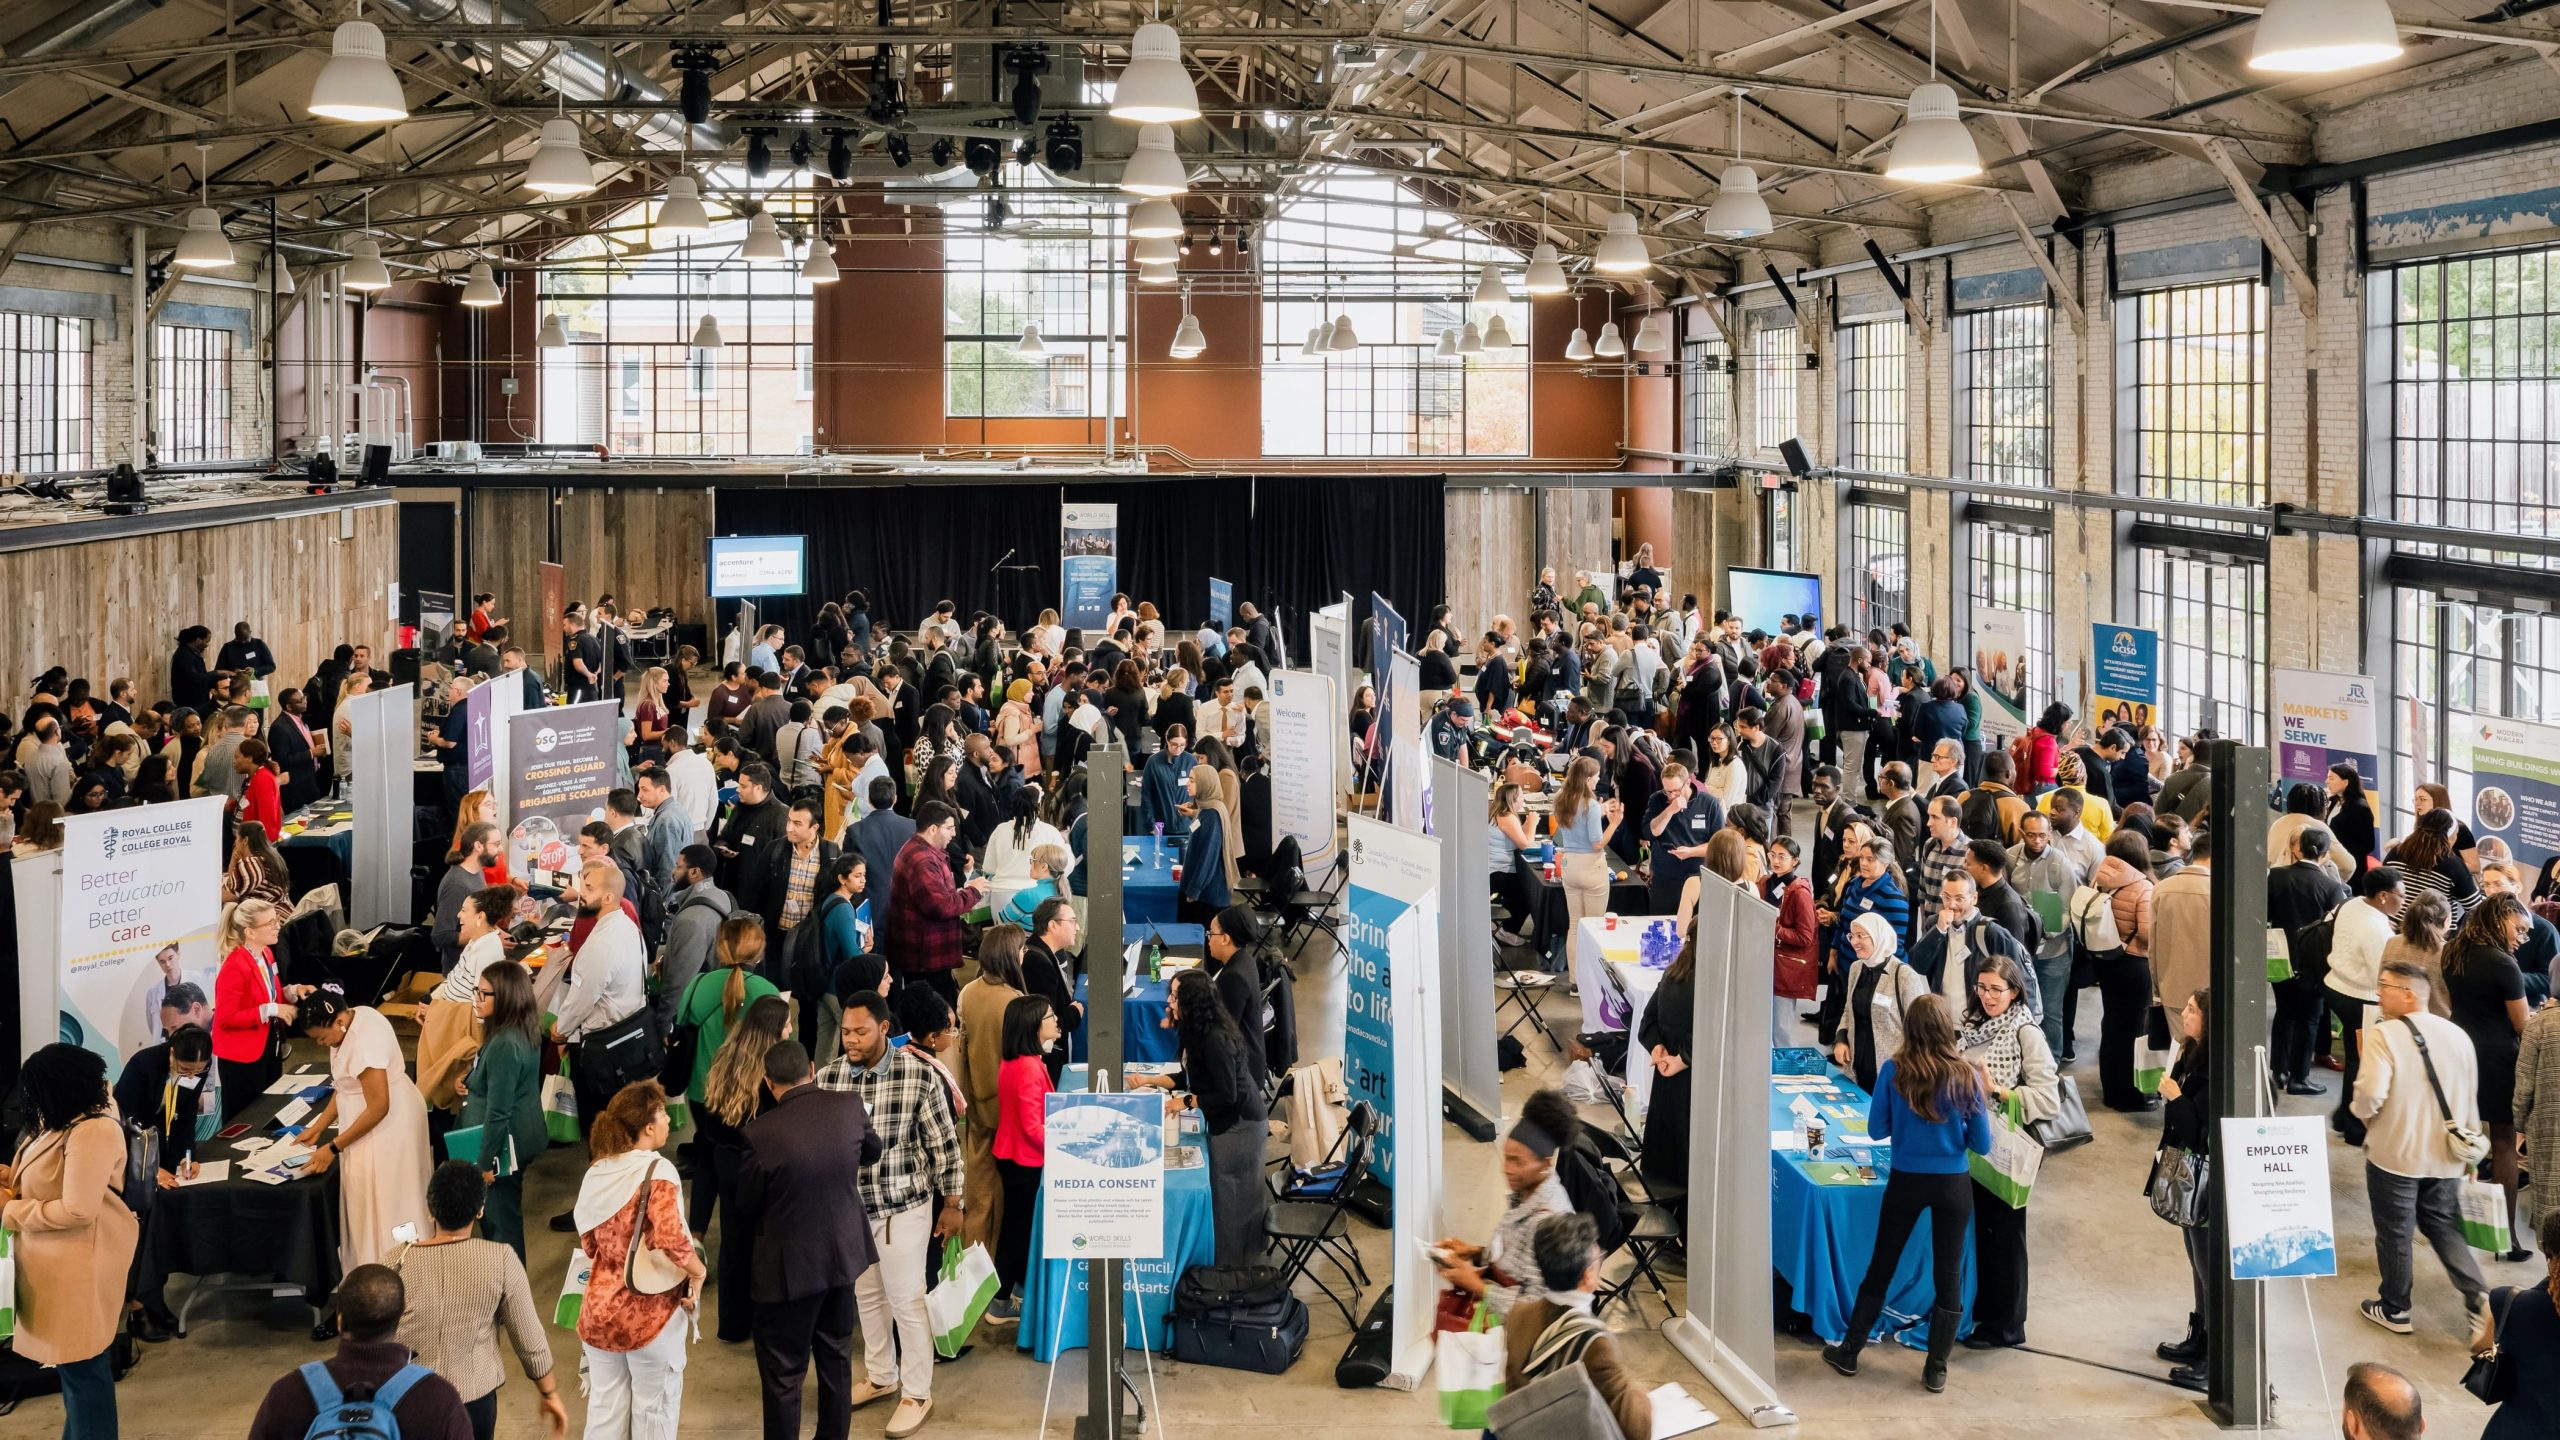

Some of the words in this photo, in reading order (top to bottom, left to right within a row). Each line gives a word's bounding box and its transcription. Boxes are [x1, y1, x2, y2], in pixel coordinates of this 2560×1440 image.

[718, 559, 754, 567] accenture
[2112, 645, 2137, 655] OCISO
[1275, 708, 1306, 719] Welcome
[2283, 703, 2348, 721] MARKETS
[2283, 716, 2304, 729] WE
[2285, 730, 2327, 745] SERVE
[2496, 729, 2524, 738] MODERN
[2496, 735, 2524, 744] NIAGARA
[525, 766, 571, 780] CROSSING
[574, 761, 606, 773] GUARD
[2475, 753, 2505, 766] MAKING
[2507, 760, 2549, 774] BUILDINGS
[519, 794, 567, 809] BRIGADIER
[569, 786, 611, 800] SCOLAIRE
[2521, 795, 2535, 803] WHO
[2544, 800, 2557, 808] ARE
[122, 828, 151, 838] ROYAL
[152, 821, 192, 834] COLLEGE
[163, 835, 192, 846] ROYAL
[540, 848, 564, 866] STOP
[81, 869, 138, 891] Better
[98, 880, 185, 907] education
[89, 906, 145, 929] Better
[112, 924, 151, 942] care
[70, 957, 126, 974] @Royal_College
[1348, 948, 1377, 982] the
[1347, 983, 1365, 1013] to
[2246, 1144, 2308, 1157] EMPLOYER
[2263, 1162, 2294, 1173] HALL
[1054, 1179, 1095, 1189] MEDIA
[1099, 1179, 1157, 1189] CONSENT
